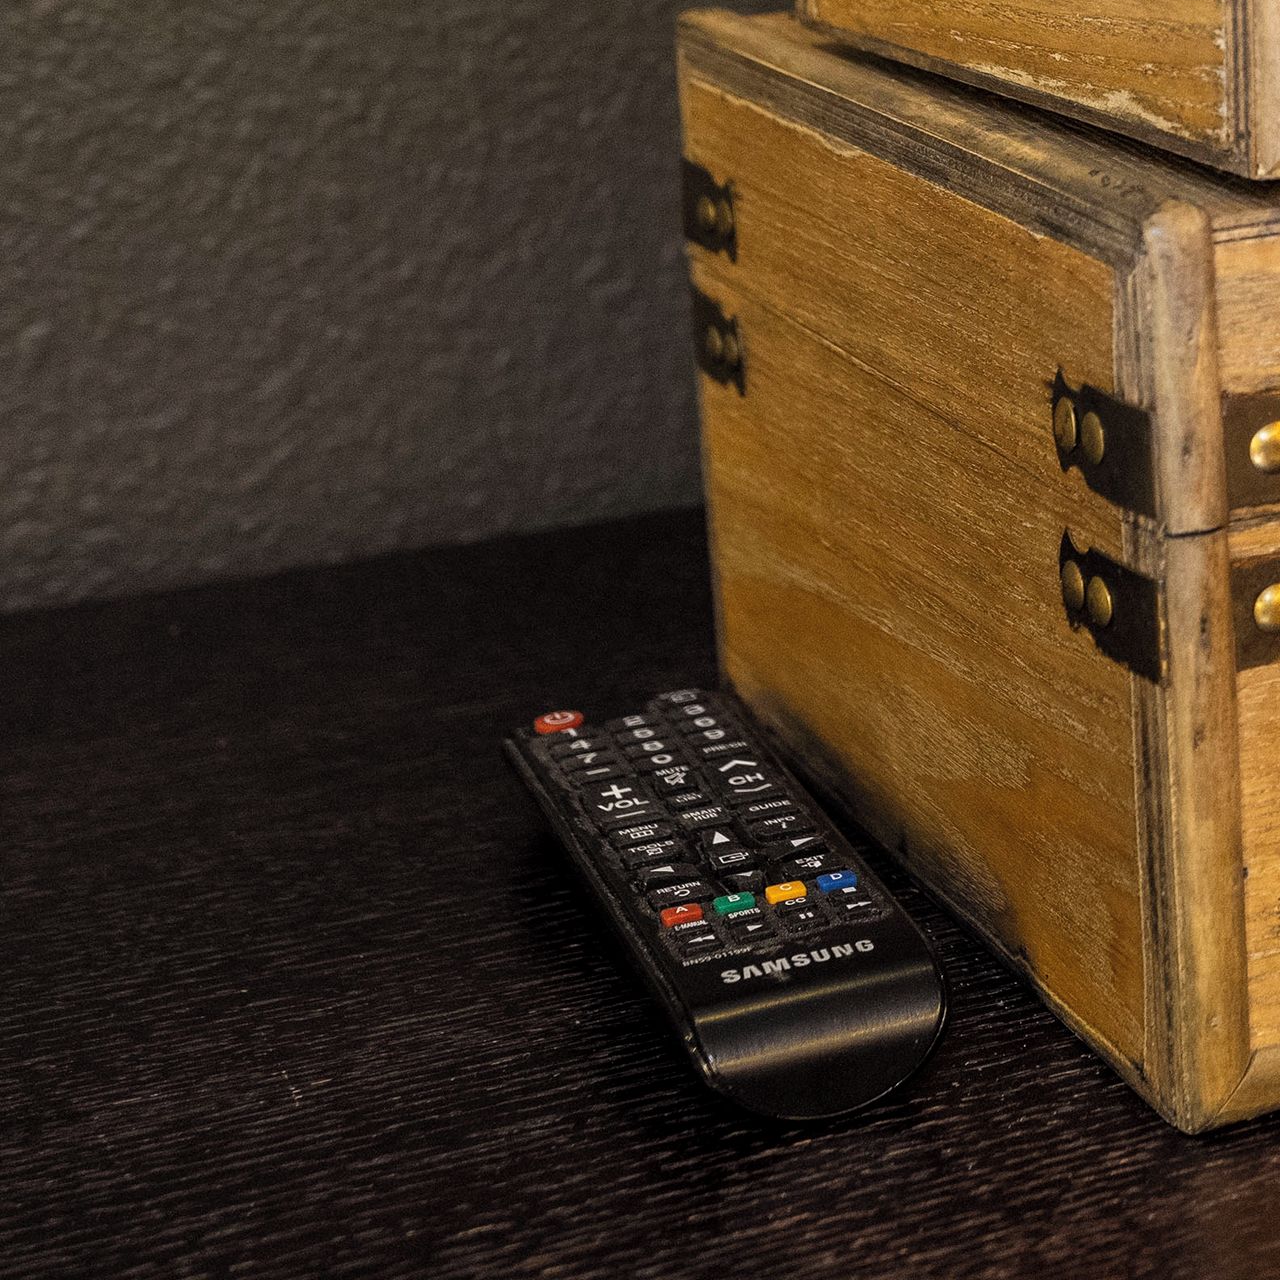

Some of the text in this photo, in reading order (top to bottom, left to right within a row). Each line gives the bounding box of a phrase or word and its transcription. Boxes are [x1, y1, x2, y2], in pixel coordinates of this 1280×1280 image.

[655, 765, 689, 777] MUTE
[728, 772, 765, 786] CH
[597, 797, 650, 812] VOL
[748, 799, 792, 812] GUIDE
[681, 806, 722, 819] SMART
[764, 815, 796, 826] INFO
[618, 823, 659, 836] MENU
[628, 839, 675, 854] TOOLS
[795, 854, 825, 865] EXIT
[830, 873, 843, 881] D
[656, 881, 701, 895] RETURN
[780, 883, 793, 891] C
[727, 894, 740, 903] B
[785, 897, 807, 906] CC
[675, 905, 689, 914] A
[728, 907, 761, 919] SPORTS
[720, 939, 875, 985] SAMSUNG
